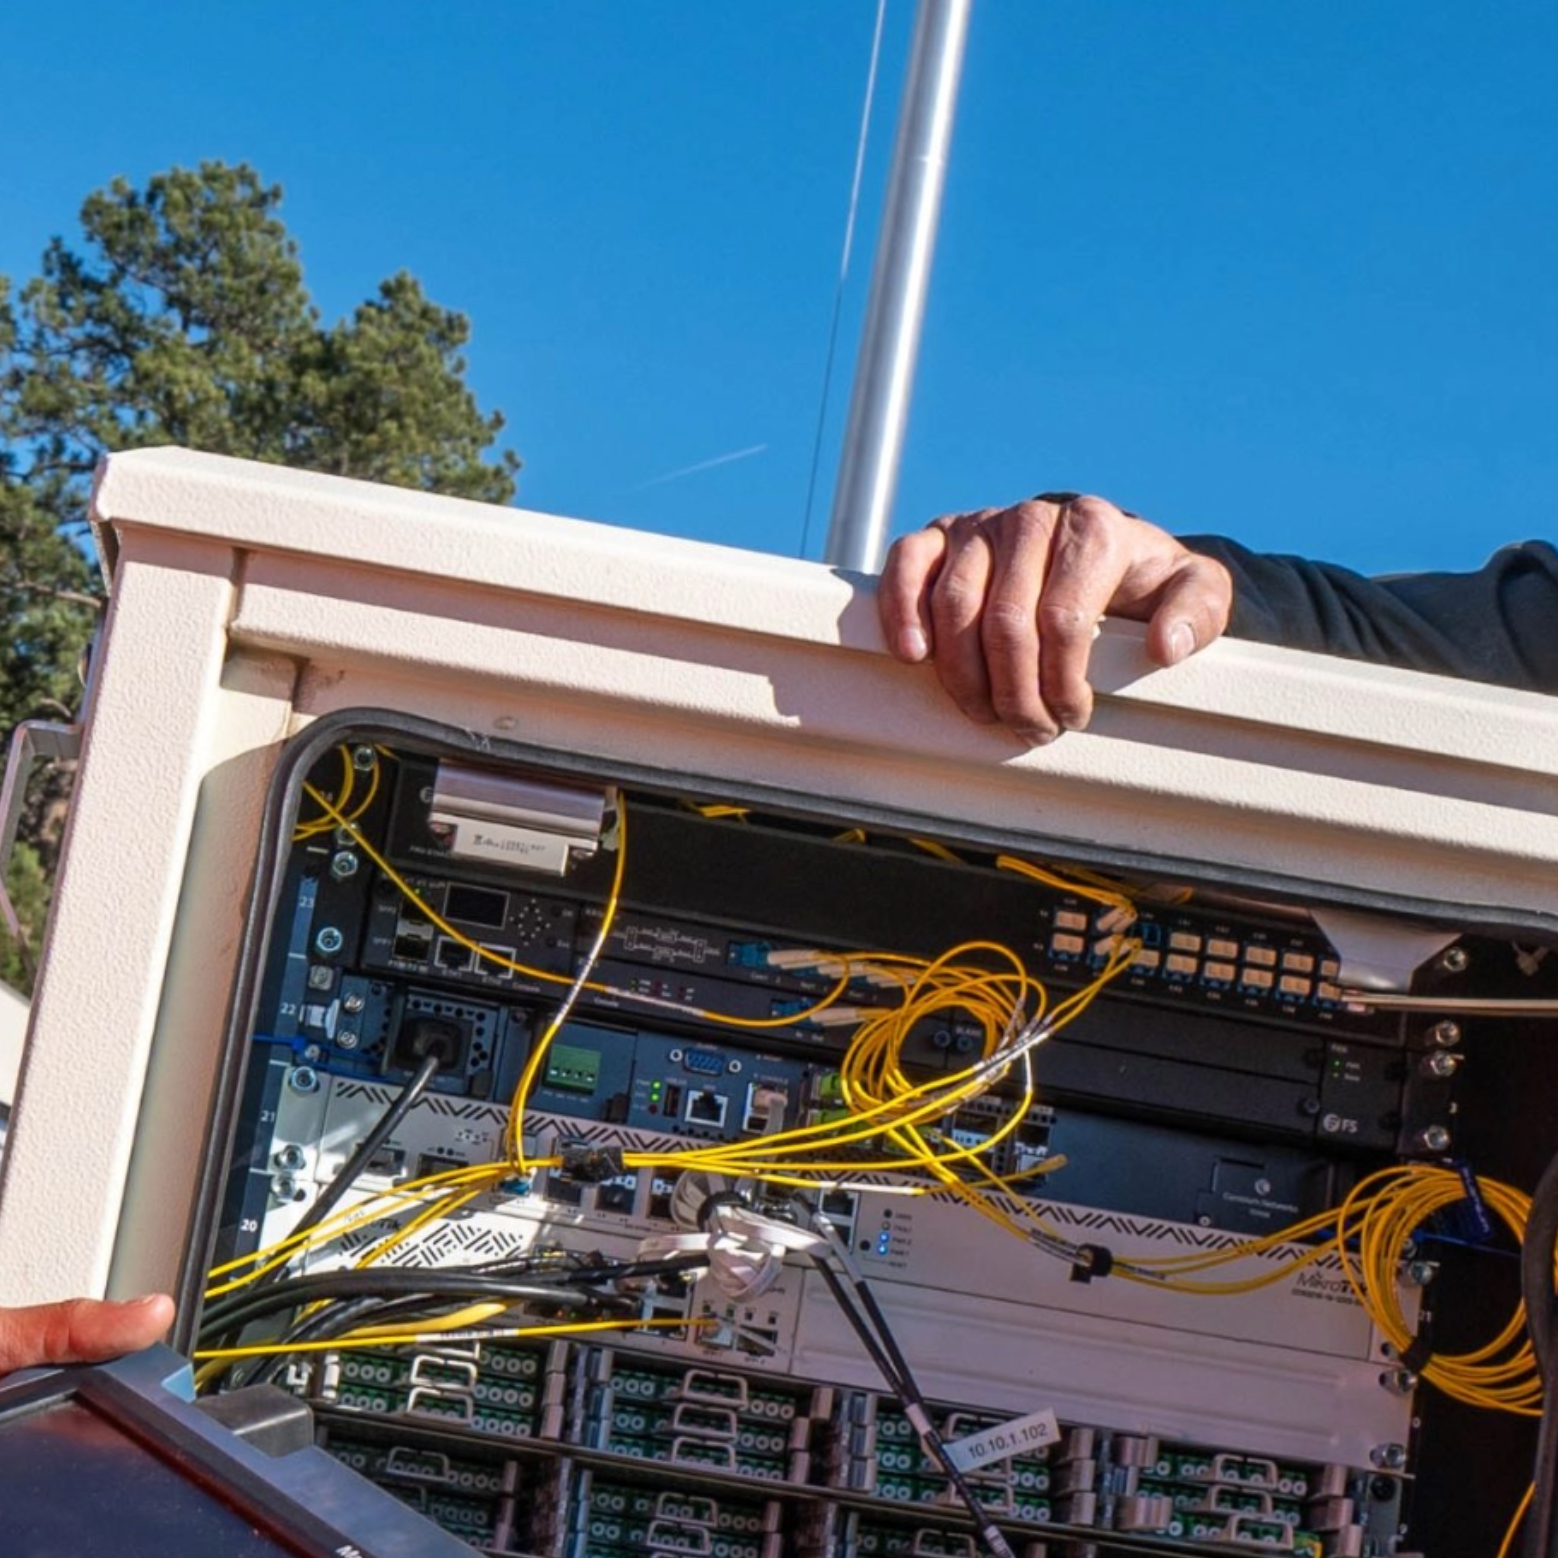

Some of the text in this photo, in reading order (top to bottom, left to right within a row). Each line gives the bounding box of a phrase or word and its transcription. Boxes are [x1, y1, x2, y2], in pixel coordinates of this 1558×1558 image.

[299, 896, 315, 908] 23
[280, 1002, 296, 1015] 22
[261, 1110, 276, 1123] 21
[1342, 1118, 1359, 1133] FS
[240, 1218, 258, 1232] 20
[1296, 1271, 1368, 1296] MikroT
[968, 1422, 1048, 1459] 10.10.1.102
